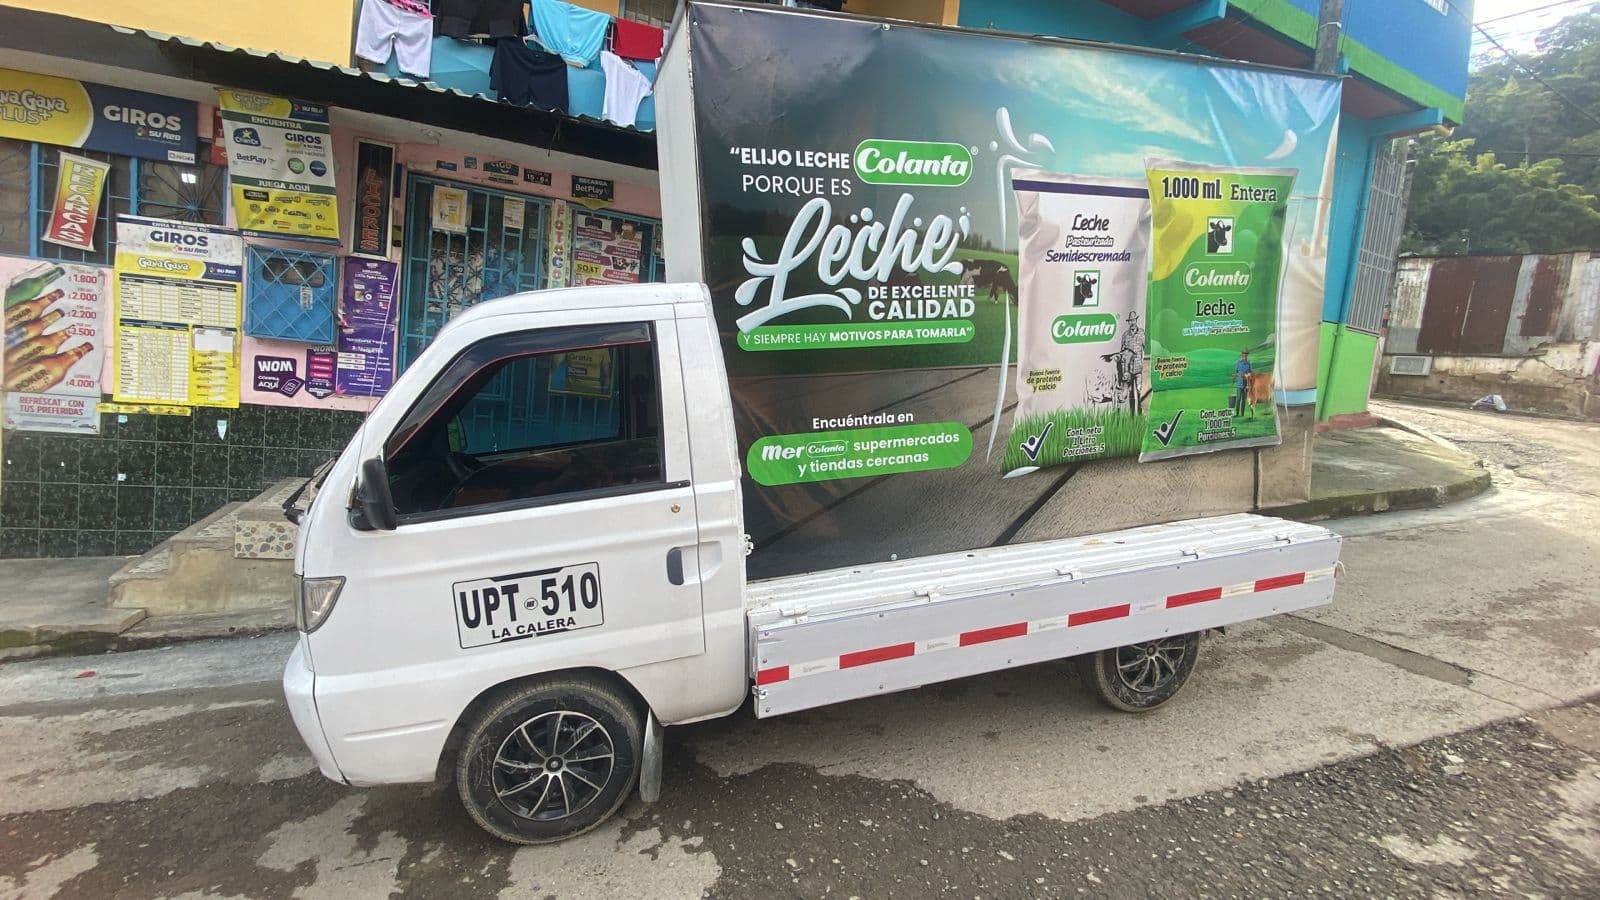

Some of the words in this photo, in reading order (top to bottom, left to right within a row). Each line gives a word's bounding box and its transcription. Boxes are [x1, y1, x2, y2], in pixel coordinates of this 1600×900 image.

[0, 105, 52, 125] LUS+
[103, 105, 181, 131] GIROS
[251, 116, 302, 130] ENCUENTRA
[285, 133, 322, 145] GIROS
[237, 153, 266, 164] BetPlay
[796, 150, 850, 169] LECHE
[857, 147, 969, 177] Colanta
[259, 180, 286, 190] JUEGA
[575, 184, 604, 195] BetPlay
[742, 174, 825, 196] PORQUE
[831, 178, 851, 196] ES
[1162, 176, 1199, 199] 1.000
[1230, 184, 1277, 202] Entera
[57, 163, 96, 242] RECARGAS
[1072, 214, 1110, 231] Leche
[150, 231, 208, 247] GIROS
[1065, 235, 1114, 248] Pasteurizada
[736, 193, 960, 333] Leche
[1045, 249, 1131, 263] Semidescremada
[577, 263, 599, 273] SOAT
[1185, 268, 1249, 287] Colanta
[868, 286, 887, 300] DE
[891, 284, 975, 299] EXCELENTE
[868, 299, 976, 320] CALIDAD
[1195, 299, 1235, 316] Leche
[743, 334, 751, 345] Y
[754, 333, 801, 345] SIEMPRE
[804, 332, 827, 343] HAY
[829, 330, 883, 343] MOTIVOS
[883, 329, 914, 340] PARA
[1052, 320, 1116, 338] Colanta
[258, 361, 294, 372] WOM
[1039, 382, 1056, 391] calcio
[20, 404, 35, 413] TUS
[38, 405, 84, 416] PREFERIDAS
[68, 400, 84, 408] CON
[812, 412, 895, 430] Encuéntrala
[897, 413, 914, 424] en
[808, 445, 845, 454] Colanta
[853, 432, 960, 453] supermercados
[797, 463, 807, 477] y
[809, 457, 863, 473] tiendas
[866, 452, 929, 468] cercanas
[460, 583, 519, 629] UPT
[541, 572, 598, 616] 510
[492, 627, 511, 639] LA
[516, 617, 576, 635] CALERA
